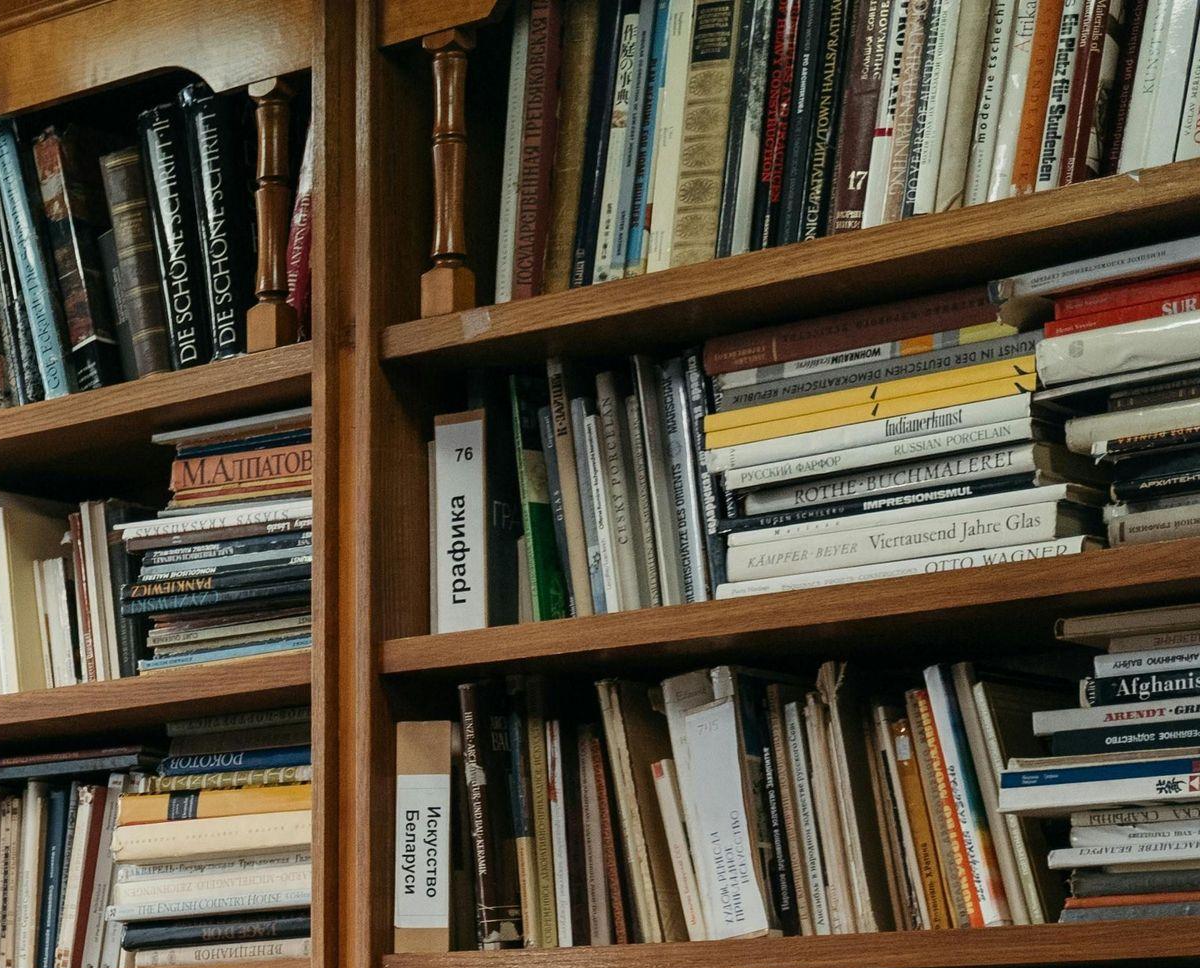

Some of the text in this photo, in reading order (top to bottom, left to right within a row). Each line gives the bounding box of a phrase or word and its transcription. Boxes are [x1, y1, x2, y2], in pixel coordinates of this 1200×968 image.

[1013, 0, 1038, 54] Afrika
[1122, 59, 1136, 81] und
[976, 74, 994, 143] moderne
[1039, 11, 1079, 183] Ein Platz für Studenten
[846, 169, 869, 190] 17
[199, 111, 238, 345] DIE SCHÖNE SCHRIFT
[156, 140, 198, 362] DIE SCHÖNE SCHRIFT
[731, 338, 1036, 404] KUNST IN DER DEUTSCHEN DEMOKRATISCHEN REPUBLIK
[881, 407, 965, 437] Indianerkunst
[453, 446, 475, 462] 76
[661, 376, 688, 527] DES ORIENTS MARSCHAK
[892, 424, 1013, 456] RUSSIAN PORCELAIN
[178, 446, 313, 486] М.АЛПАТОВ
[739, 455, 842, 483] РУССКИЙ ФАРФОР
[791, 448, 1018, 505] ROTHE BUCHMALEREI
[862, 484, 973, 511] IMPRESIONISMUL
[235, 507, 288, 526] STASYS
[813, 511, 1041, 559] BEYER Viertausend Jahre Glas
[446, 495, 470, 604] графика
[141, 565, 216, 582] MONGOLISCHE MALEREI
[922, 556, 973, 574] OTTO
[129, 576, 212, 597] PANKIEWICZ
[1112, 658, 1144, 670] ВАЙНУ
[1102, 705, 1167, 724] ARENDT
[1104, 732, 1155, 744] ЗОДЧЕСТВО
[169, 751, 245, 772] РОКОТОВ
[1088, 810, 1159, 823] СКАРЫНЫ
[789, 743, 826, 927] Ансамбль народном зодчестве русского
[398, 808, 421, 894] Беларуси
[423, 805, 441, 897] Искусство
[1078, 845, 1133, 856] БЕЛАРУСІ
[155, 894, 245, 915] ENGLISH COUNTRY
[193, 942, 284, 960] ВЕНЕЦИАНОВ
